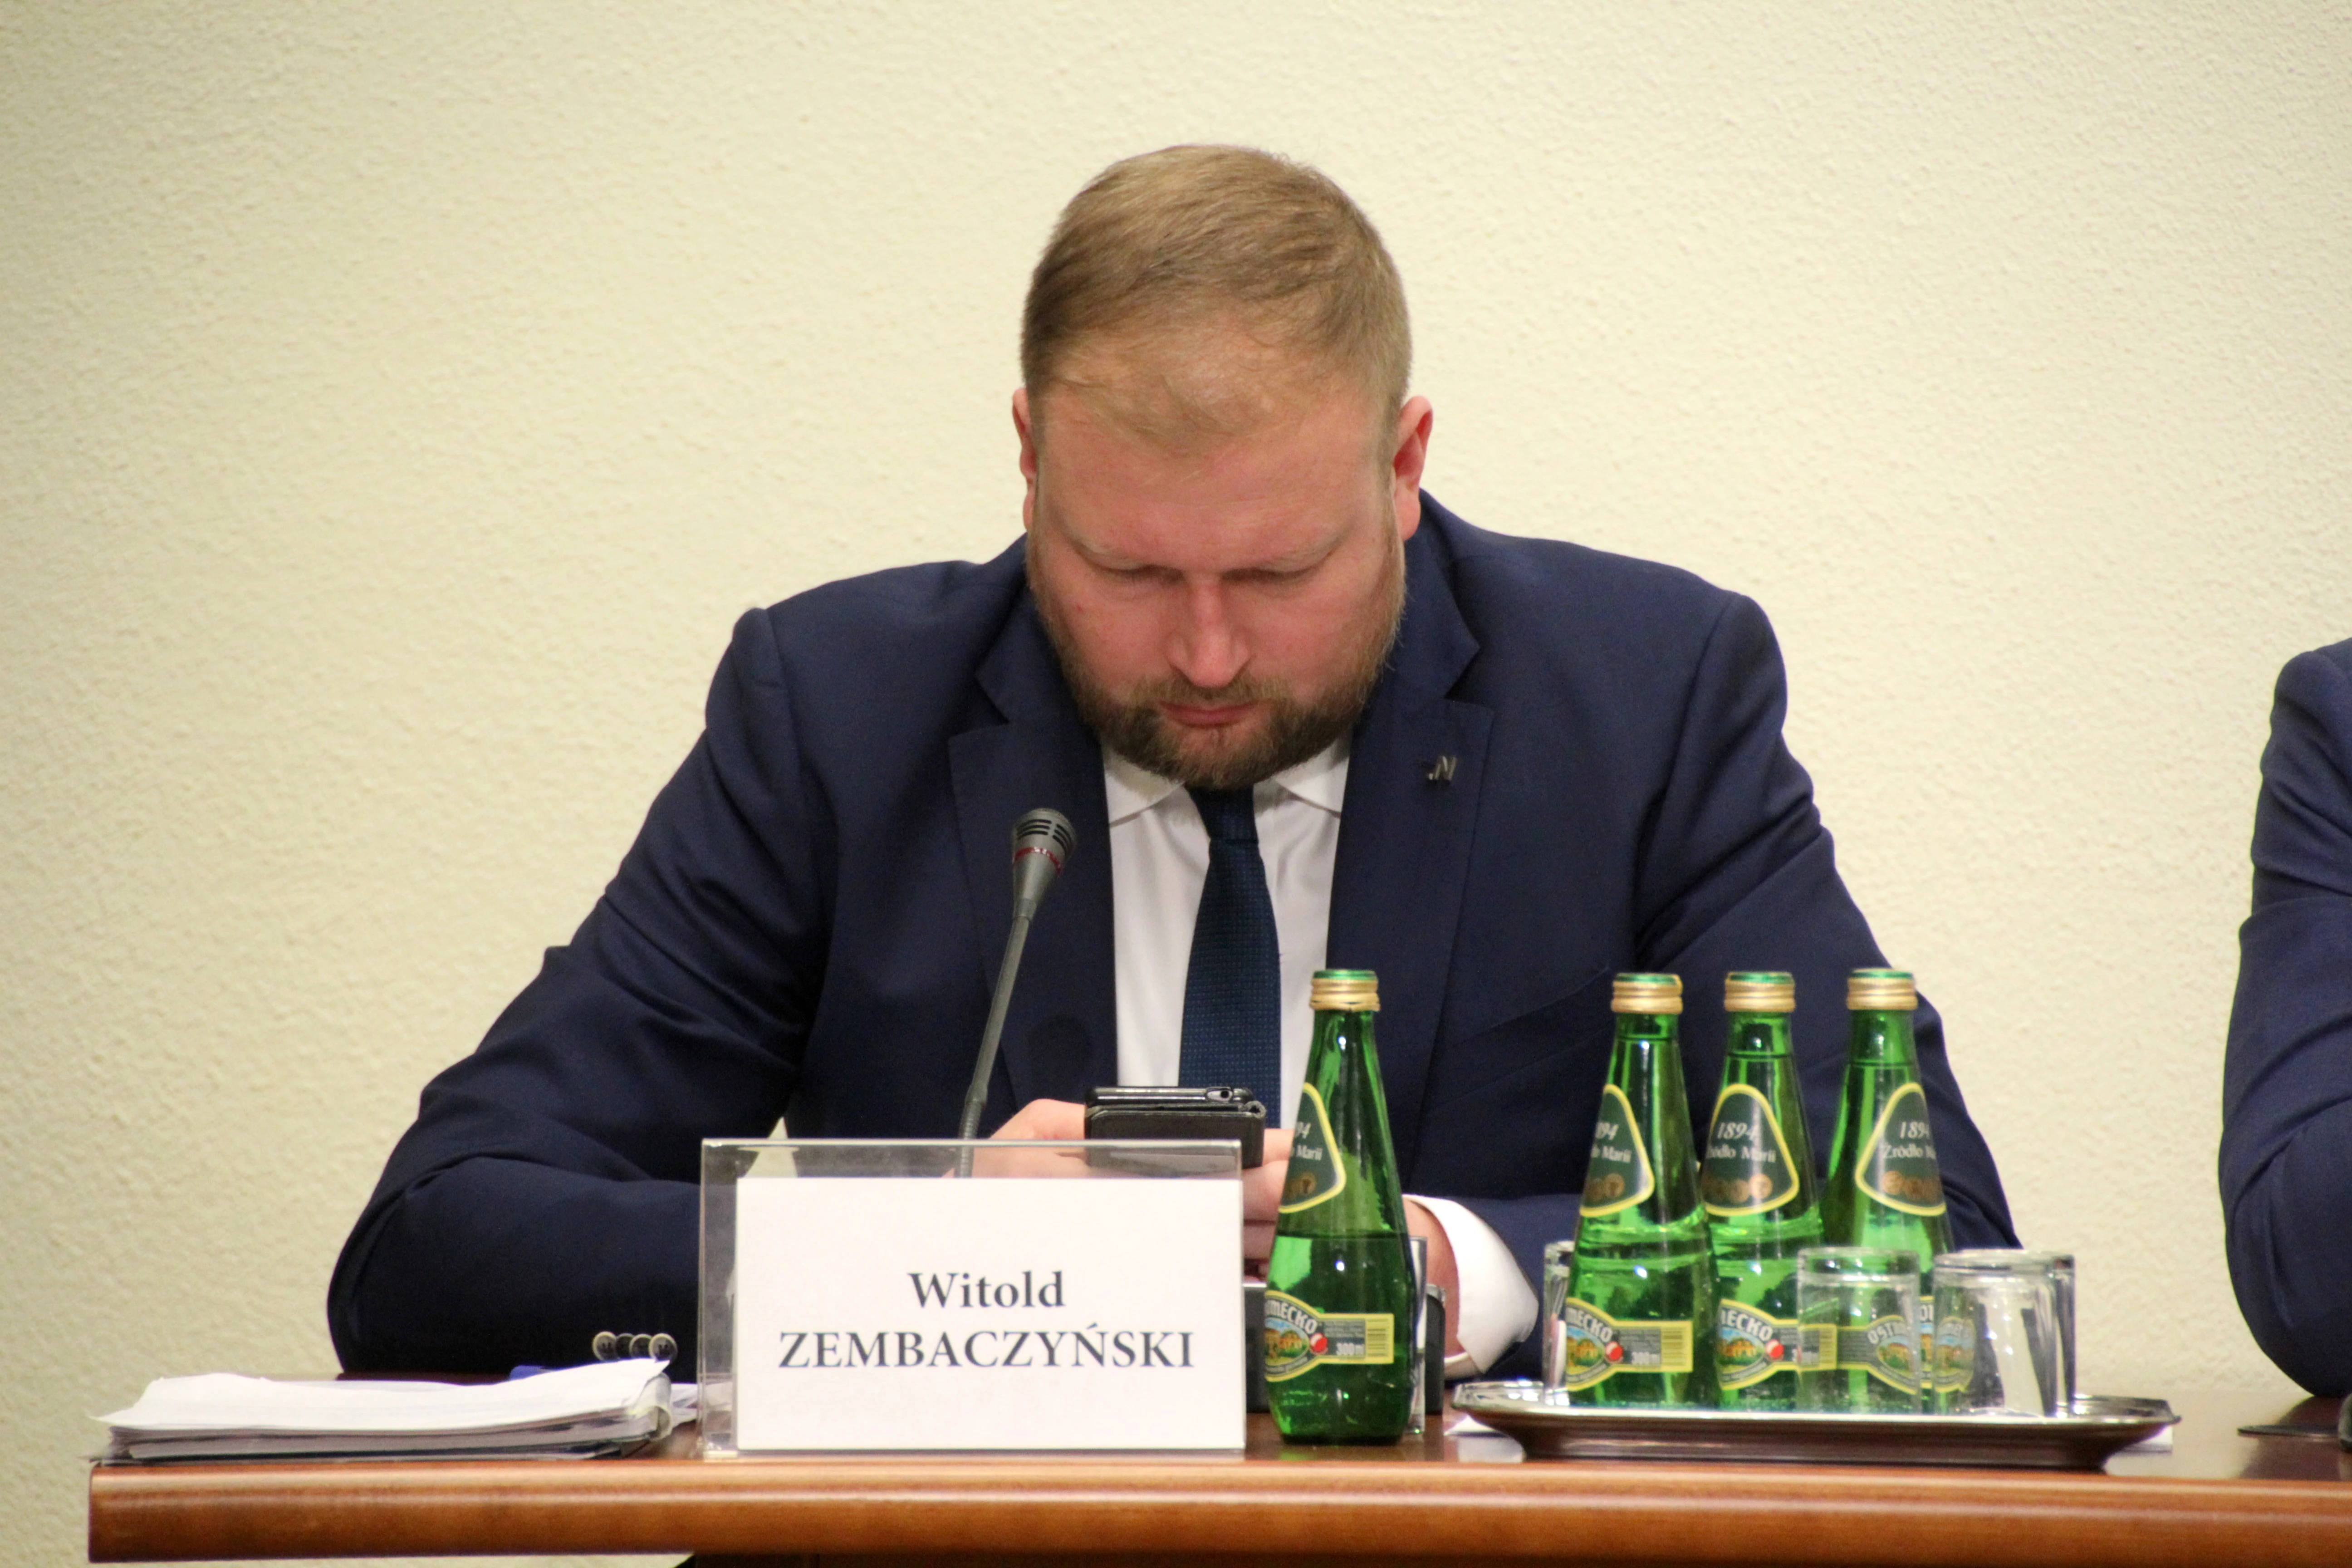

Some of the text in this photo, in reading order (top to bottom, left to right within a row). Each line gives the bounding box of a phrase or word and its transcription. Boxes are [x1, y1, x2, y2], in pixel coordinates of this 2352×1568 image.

[1717, 1122, 1760, 1140] 1894
[909, 1270, 1064, 1308] Witold
[779, 1323, 1194, 1368] ZEMBACZYŃSKI
